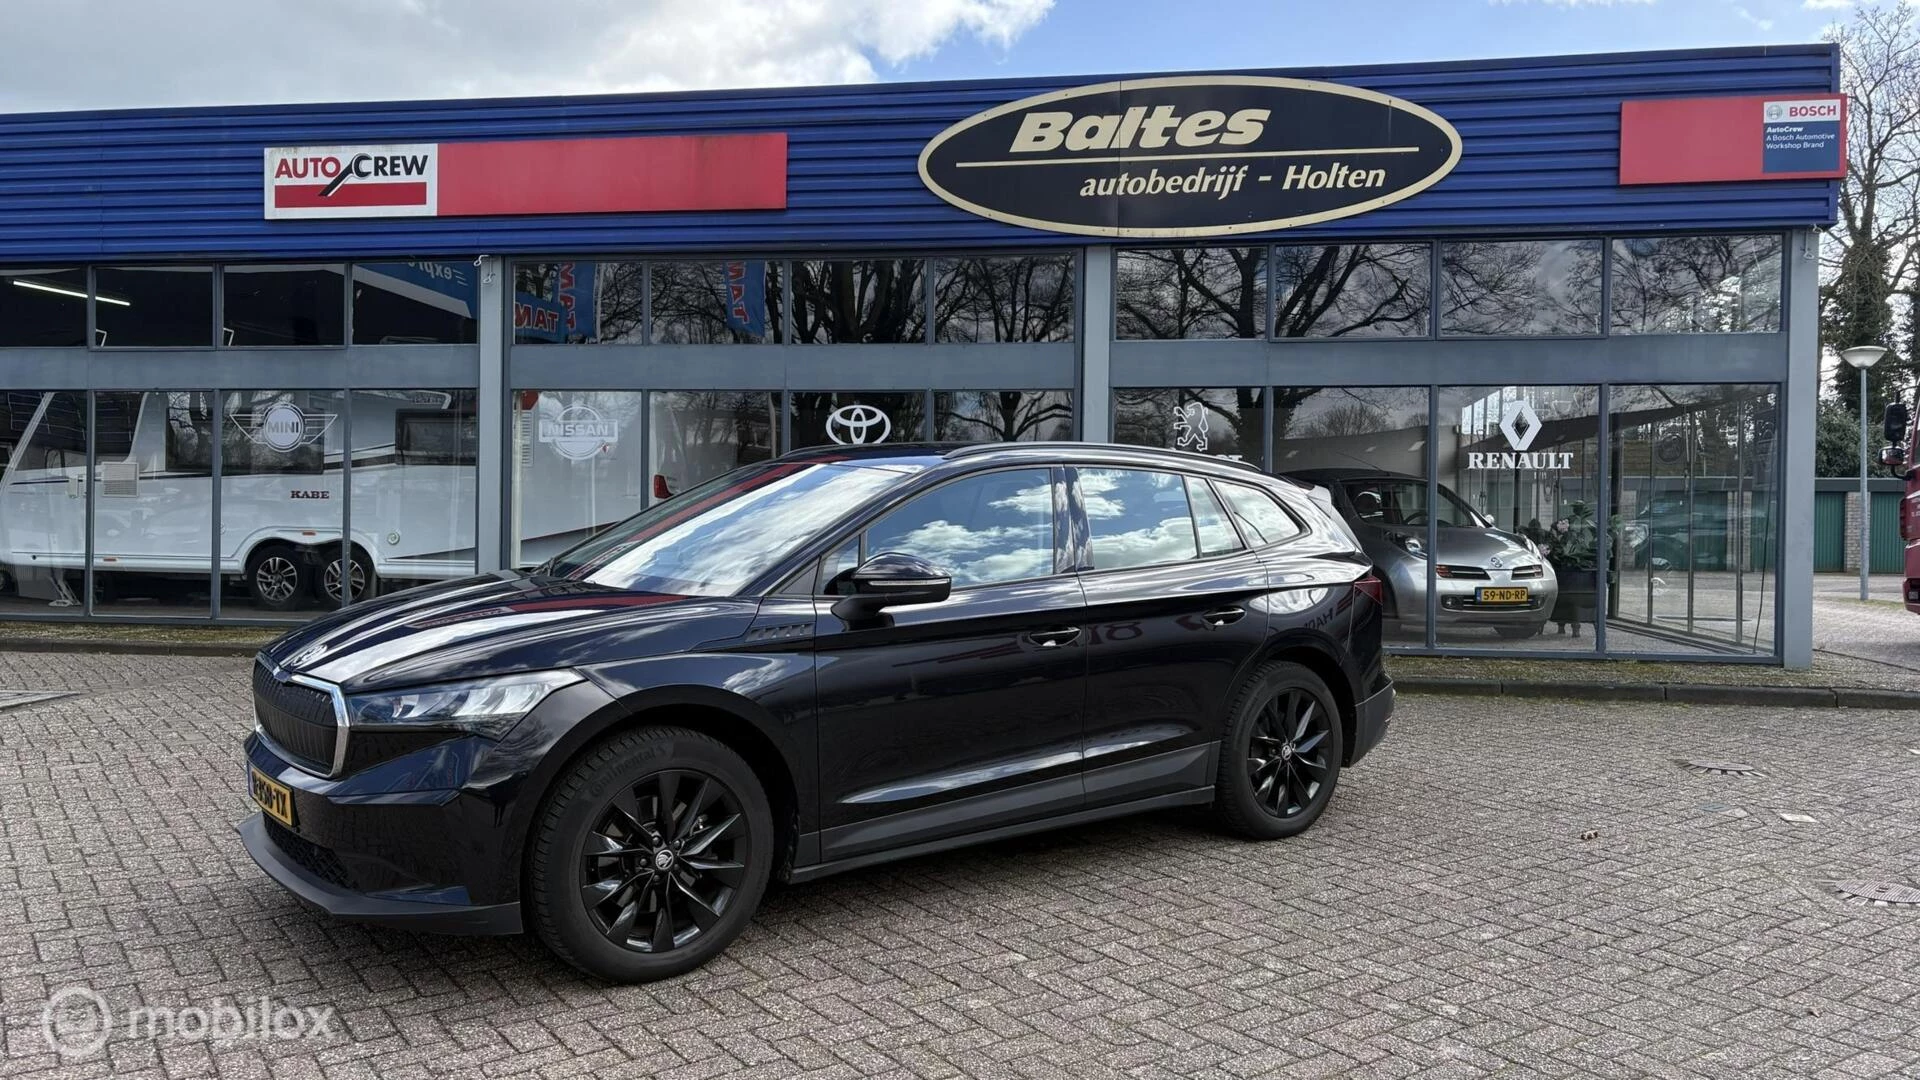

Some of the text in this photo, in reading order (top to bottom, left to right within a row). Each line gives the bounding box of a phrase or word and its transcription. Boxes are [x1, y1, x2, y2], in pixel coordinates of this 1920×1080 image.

[1789, 105, 1836, 117] BOSCH
[1009, 105, 1271, 152] Baltes
[275, 154, 428, 179] AUTO CREW
[1080, 165, 1248, 200] autobedrijf
[1282, 162, 1386, 190] Holten
[268, 422, 299, 434] MINI
[548, 424, 608, 436] NISSAN
[1467, 452, 1574, 469] RENAULT
[291, 491, 330, 499] KABE
[1483, 590, 1526, 601] 59-ND-RP
